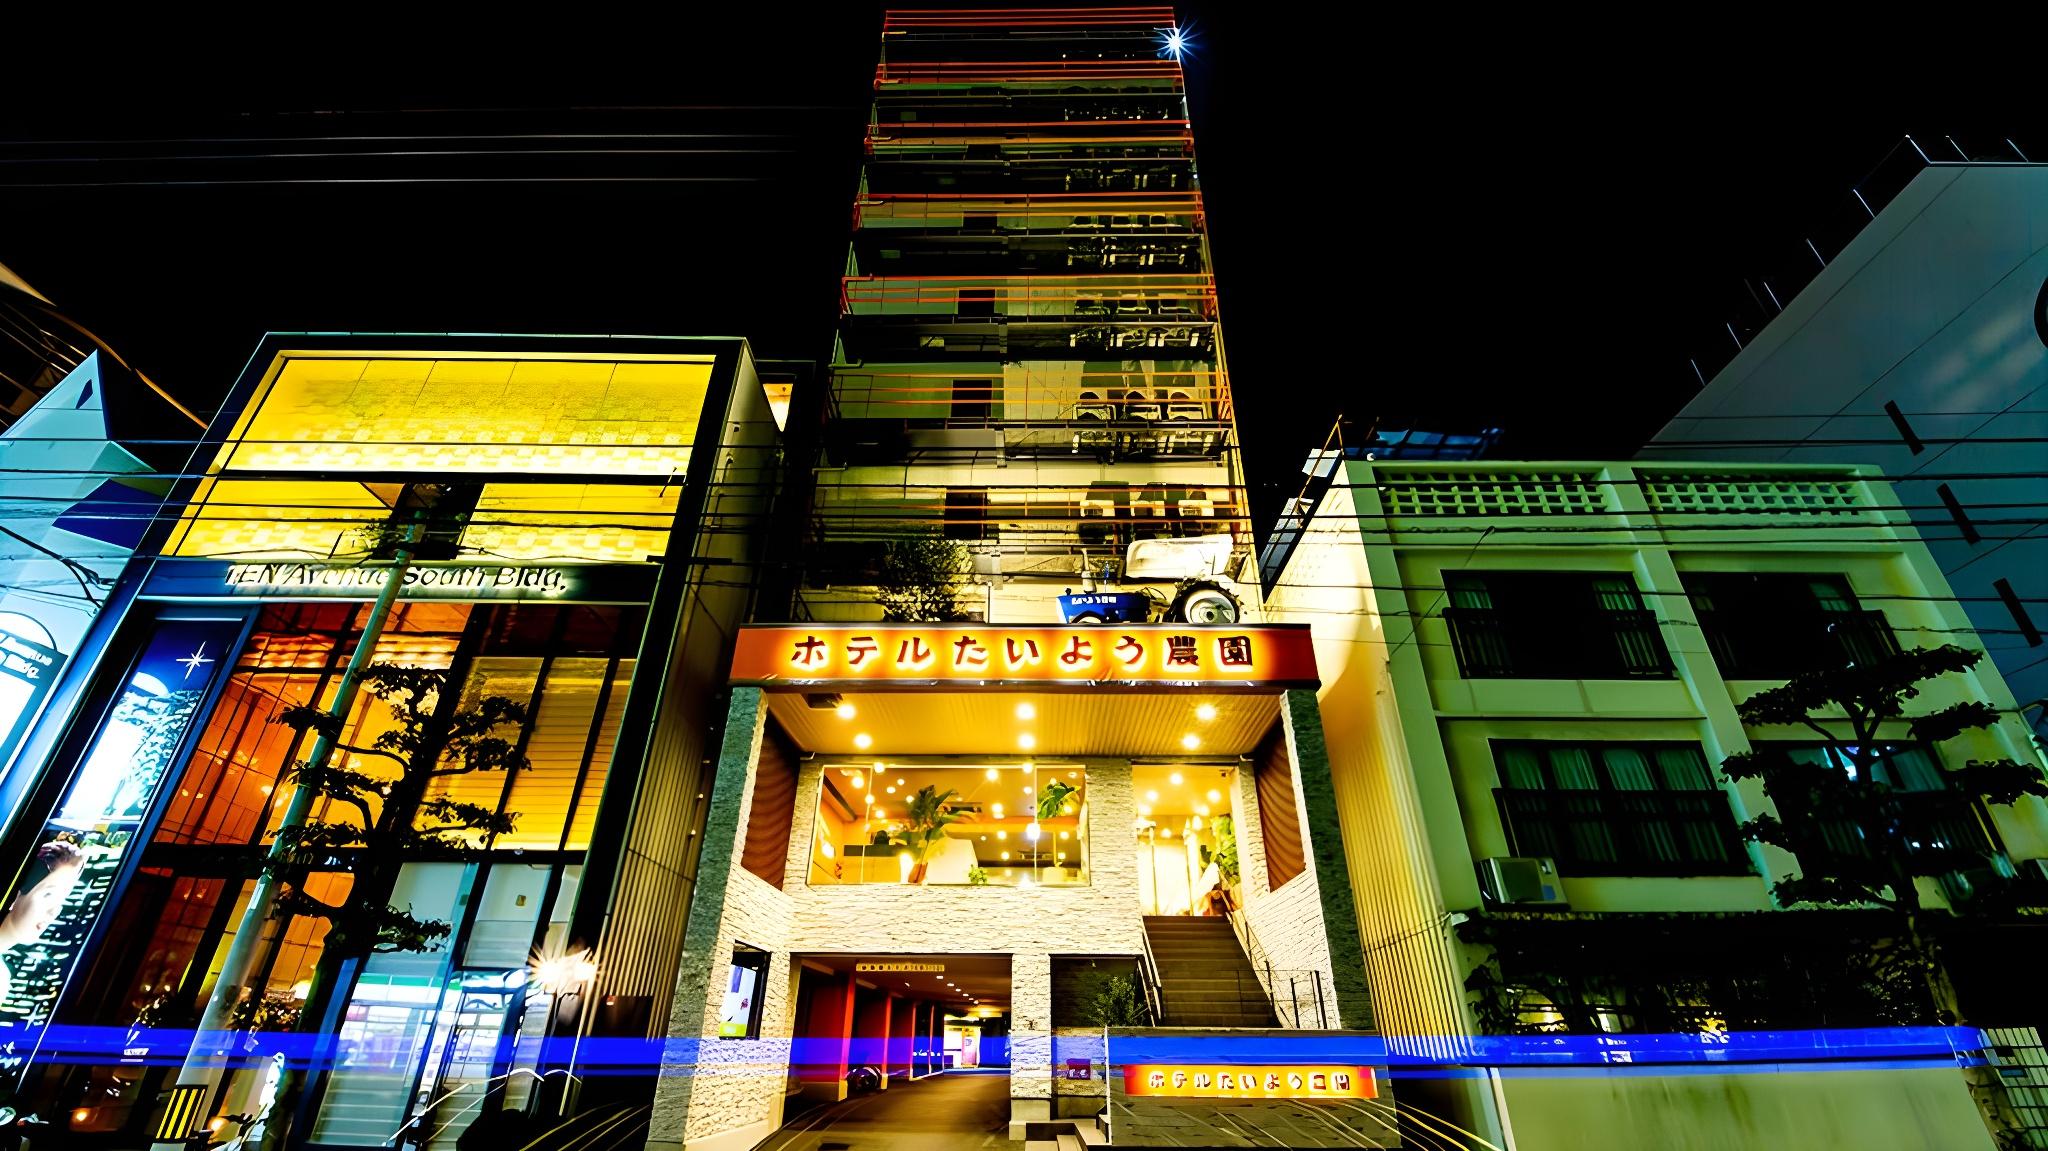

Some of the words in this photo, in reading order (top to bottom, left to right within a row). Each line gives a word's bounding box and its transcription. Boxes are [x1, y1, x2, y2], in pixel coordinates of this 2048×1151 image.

[403, 565, 486, 586] South
[493, 566, 566, 592] Bldg.
[791, 635, 1253, 668] ホテルたいよう農園
